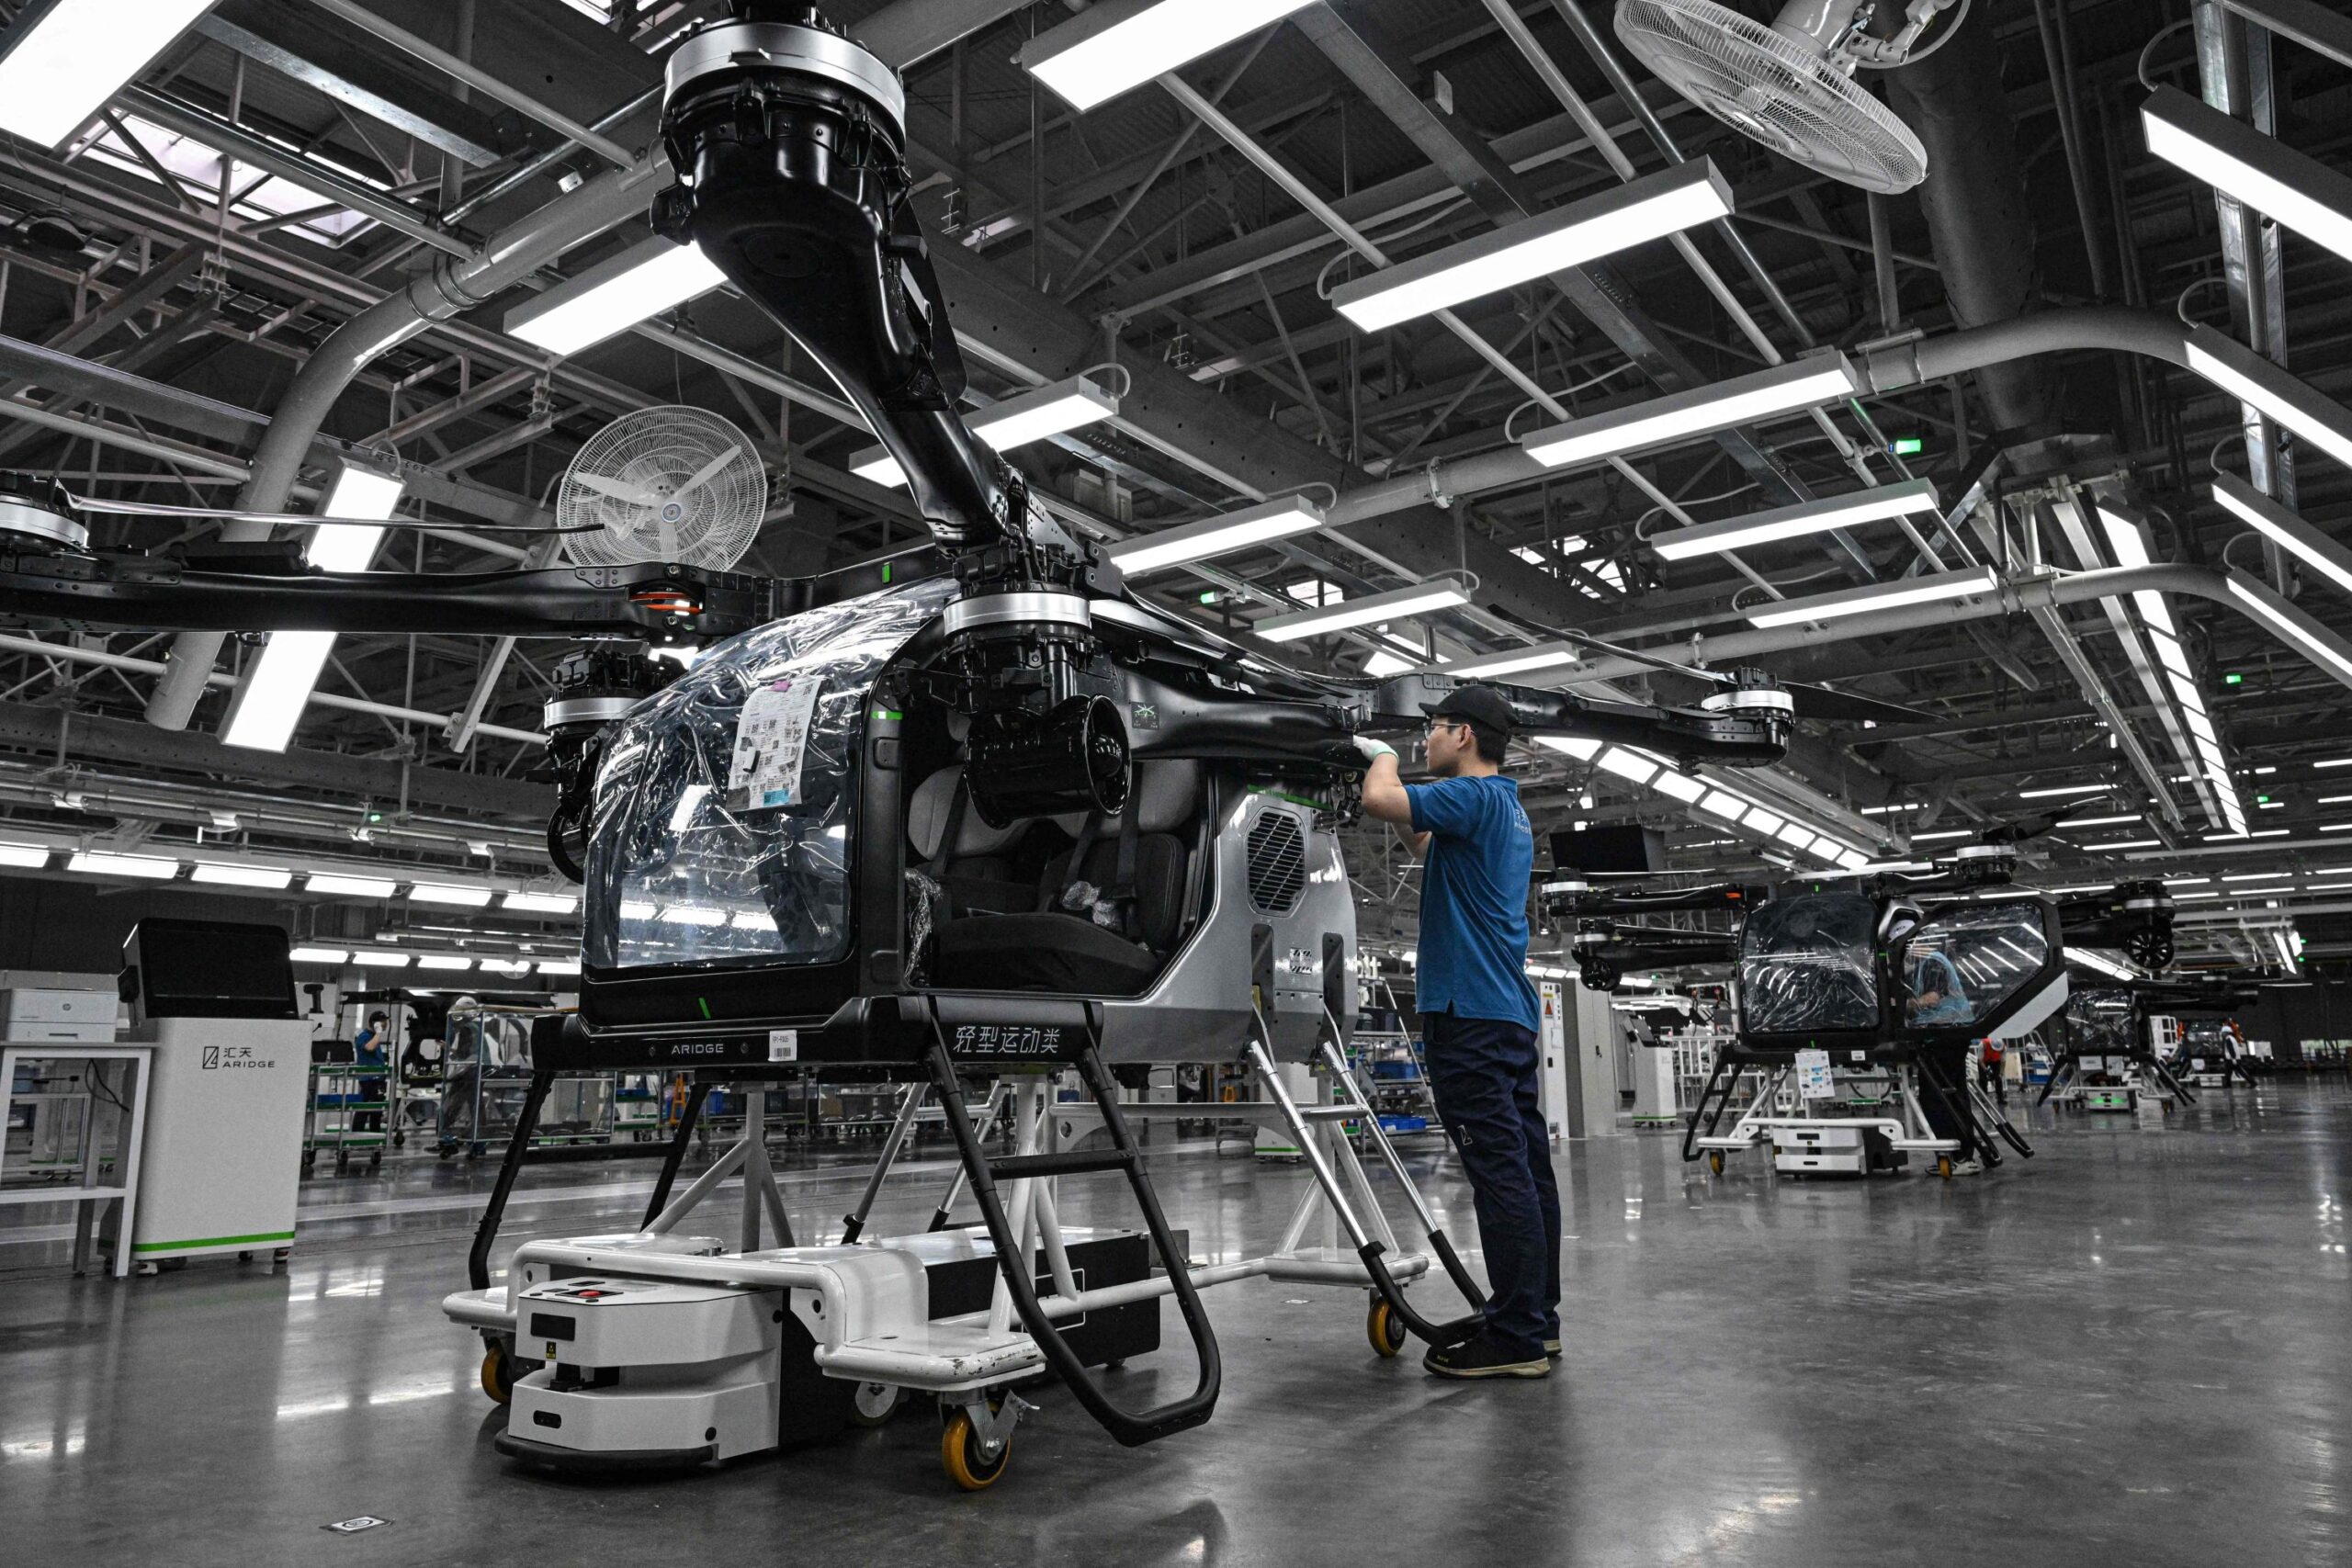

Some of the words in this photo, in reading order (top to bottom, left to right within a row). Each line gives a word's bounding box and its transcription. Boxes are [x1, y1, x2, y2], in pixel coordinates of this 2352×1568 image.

[954, 1026, 1060, 1054] 轻型运动类
[223, 1047, 252, 1058] 汇天
[671, 1043, 724, 1055] ARIDGE
